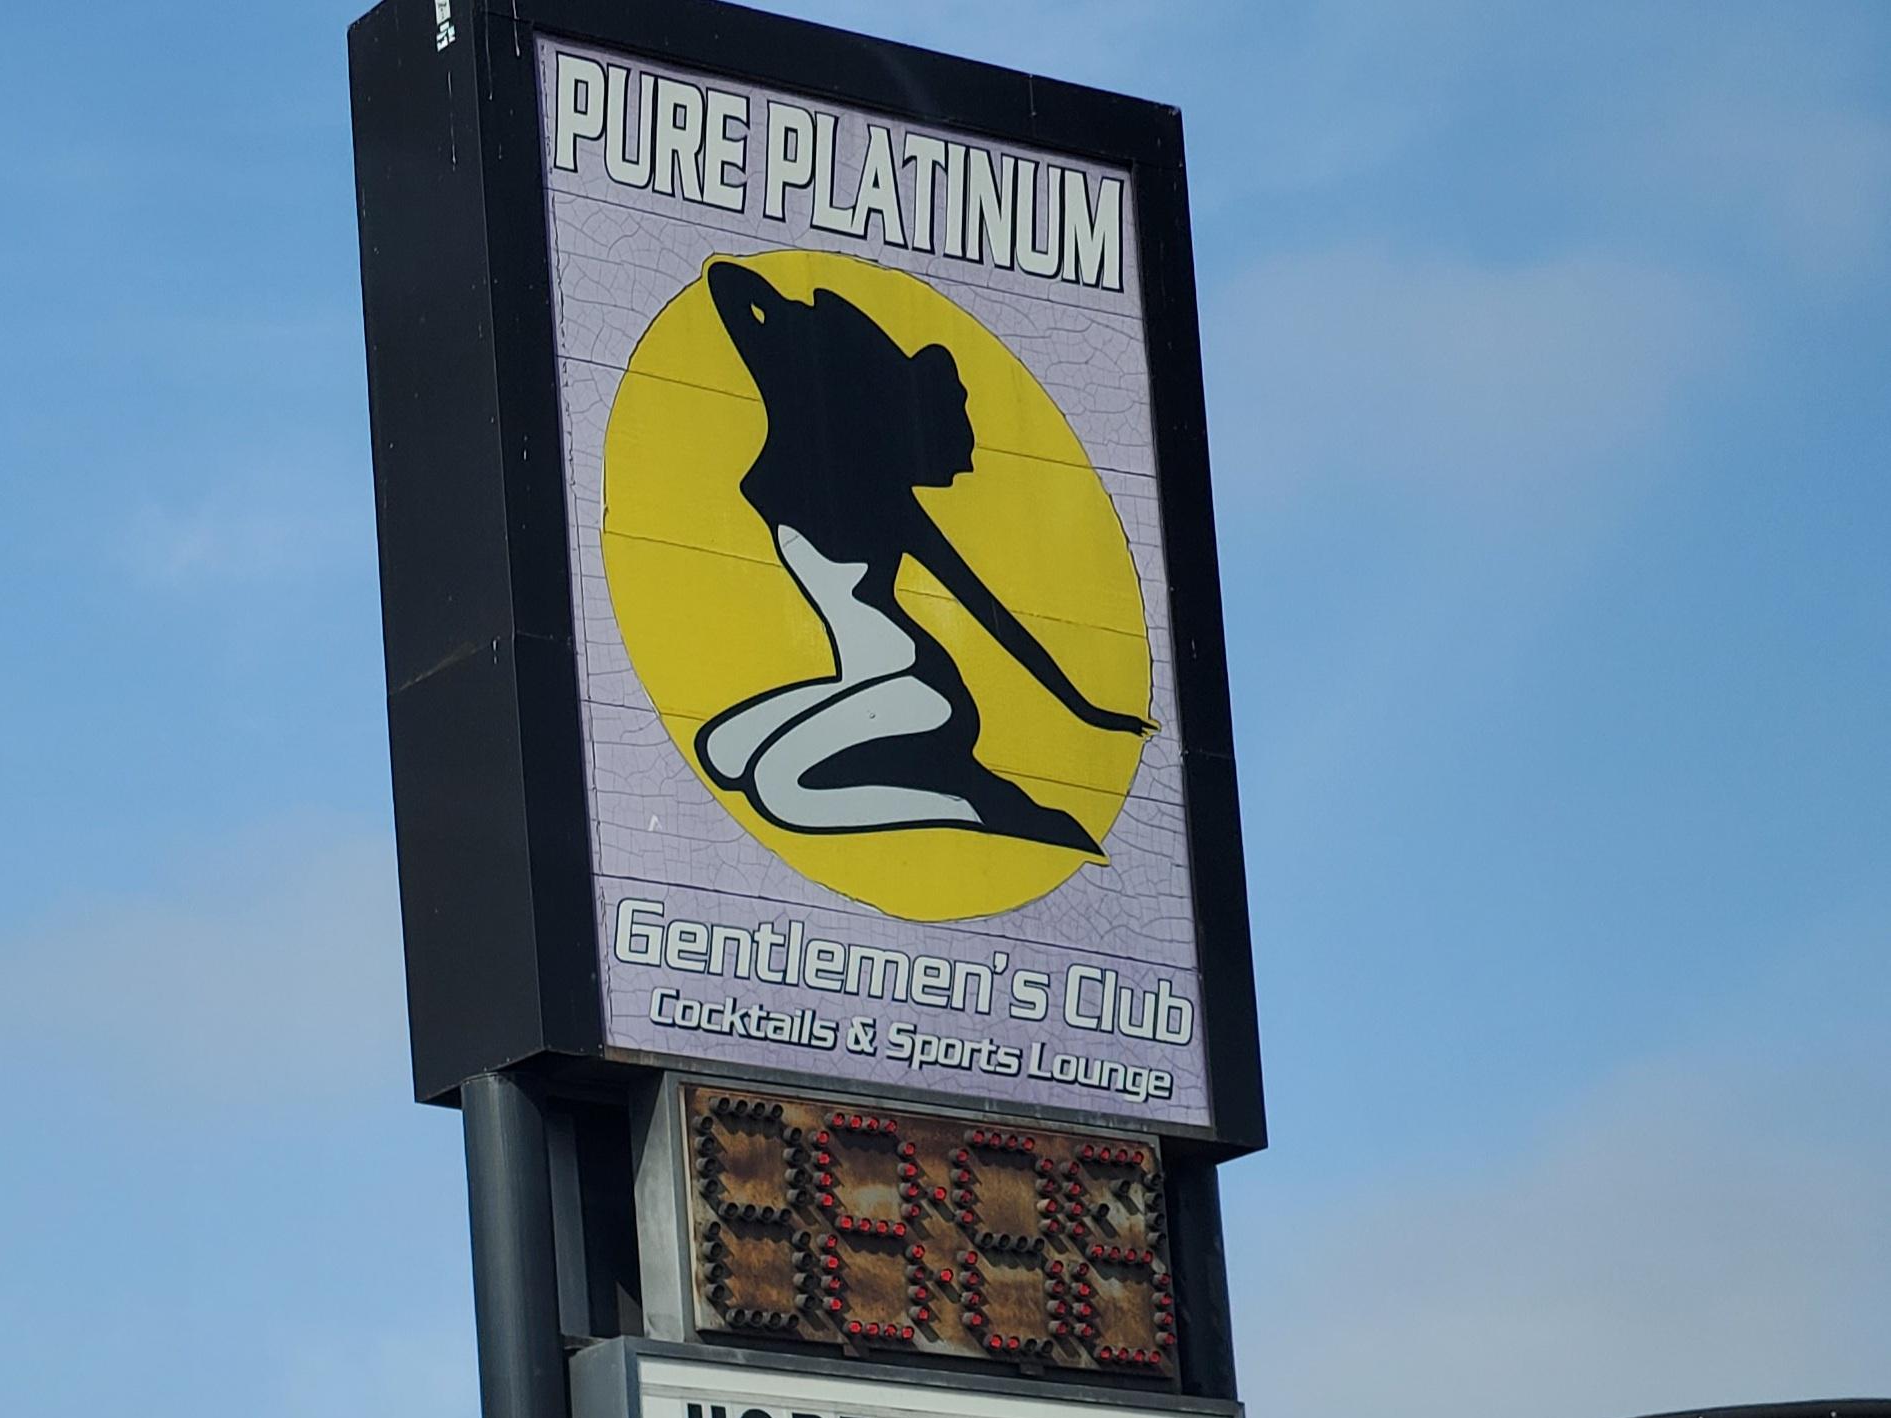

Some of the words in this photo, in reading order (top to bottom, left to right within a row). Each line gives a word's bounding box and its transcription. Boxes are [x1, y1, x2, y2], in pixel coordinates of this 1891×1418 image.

[554, 52, 751, 214] PURE
[762, 99, 1125, 294] PLATINUM
[614, 897, 1052, 1023] Gentlemen's
[1063, 963, 1196, 1047] Club
[648, 985, 839, 1050] Cocktails
[846, 1016, 879, 1056] &
[884, 1022, 1022, 1079] Sports
[1026, 1042, 1175, 1103] Lounge
